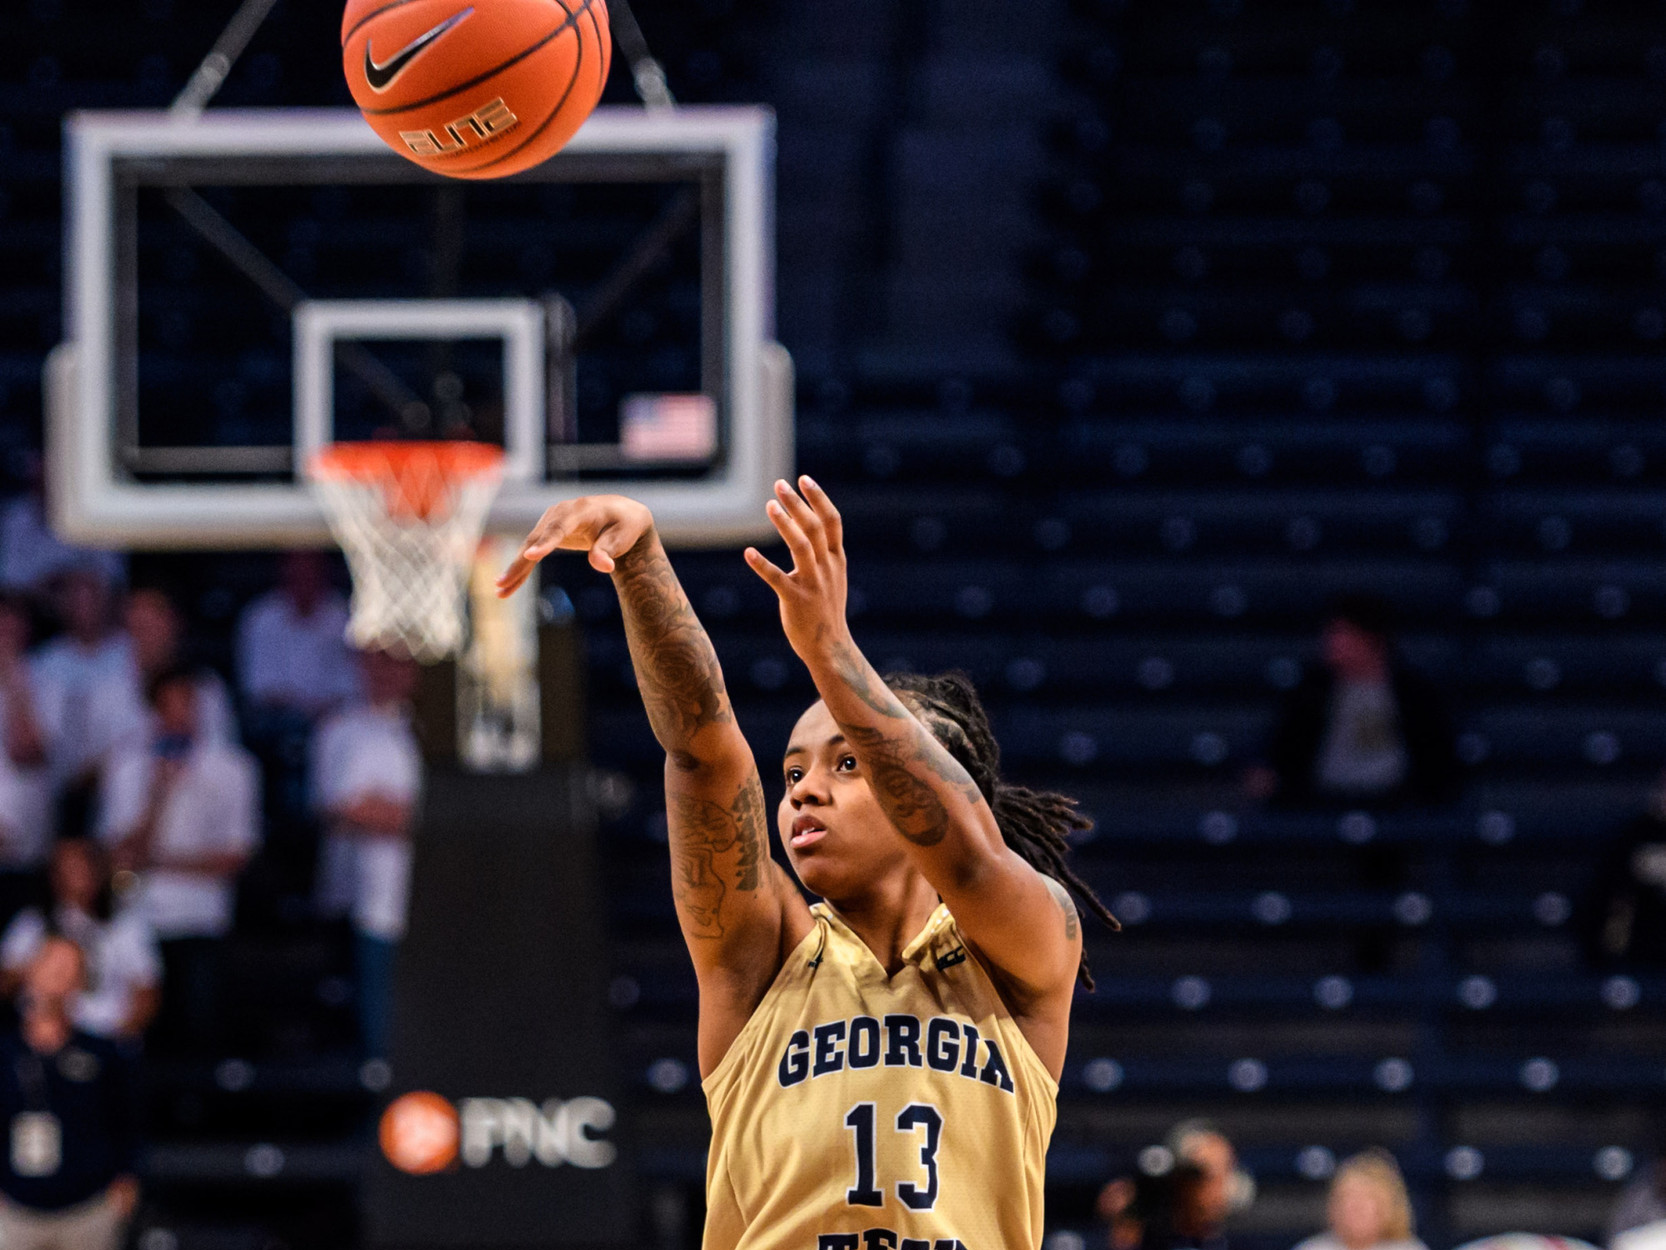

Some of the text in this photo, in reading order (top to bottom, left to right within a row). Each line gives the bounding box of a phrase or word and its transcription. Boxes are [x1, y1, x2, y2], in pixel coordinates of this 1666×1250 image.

[778, 1013, 1015, 1095] GEORGIA
[461, 1095, 618, 1170] PNC
[843, 1101, 946, 1213] 13
